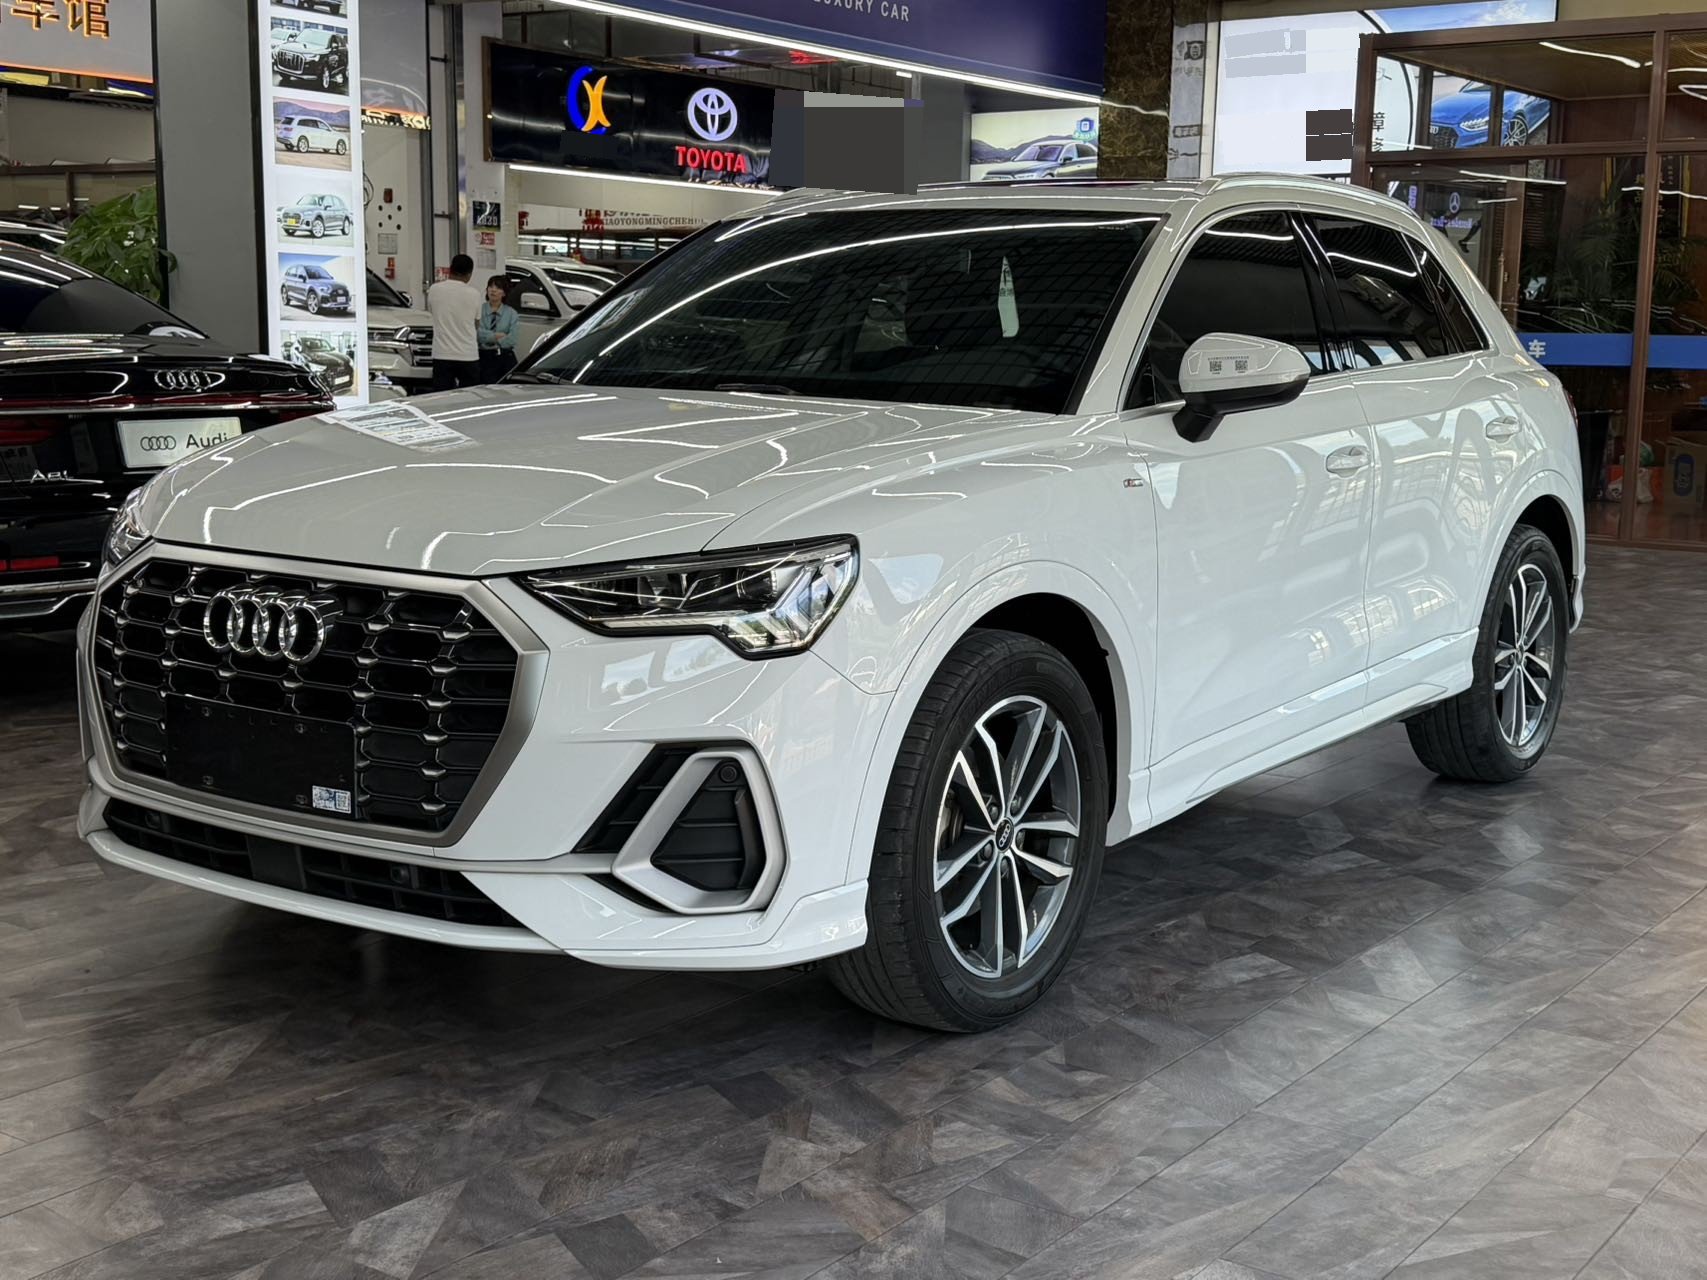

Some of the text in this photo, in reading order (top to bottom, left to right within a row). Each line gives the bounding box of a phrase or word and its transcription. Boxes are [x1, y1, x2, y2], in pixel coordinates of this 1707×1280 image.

[880, 1, 909, 22] CAR
[675, 145, 748, 174] TOYOTA
[1528, 339, 1546, 358] 车
[186, 432, 227, 449] Audi
